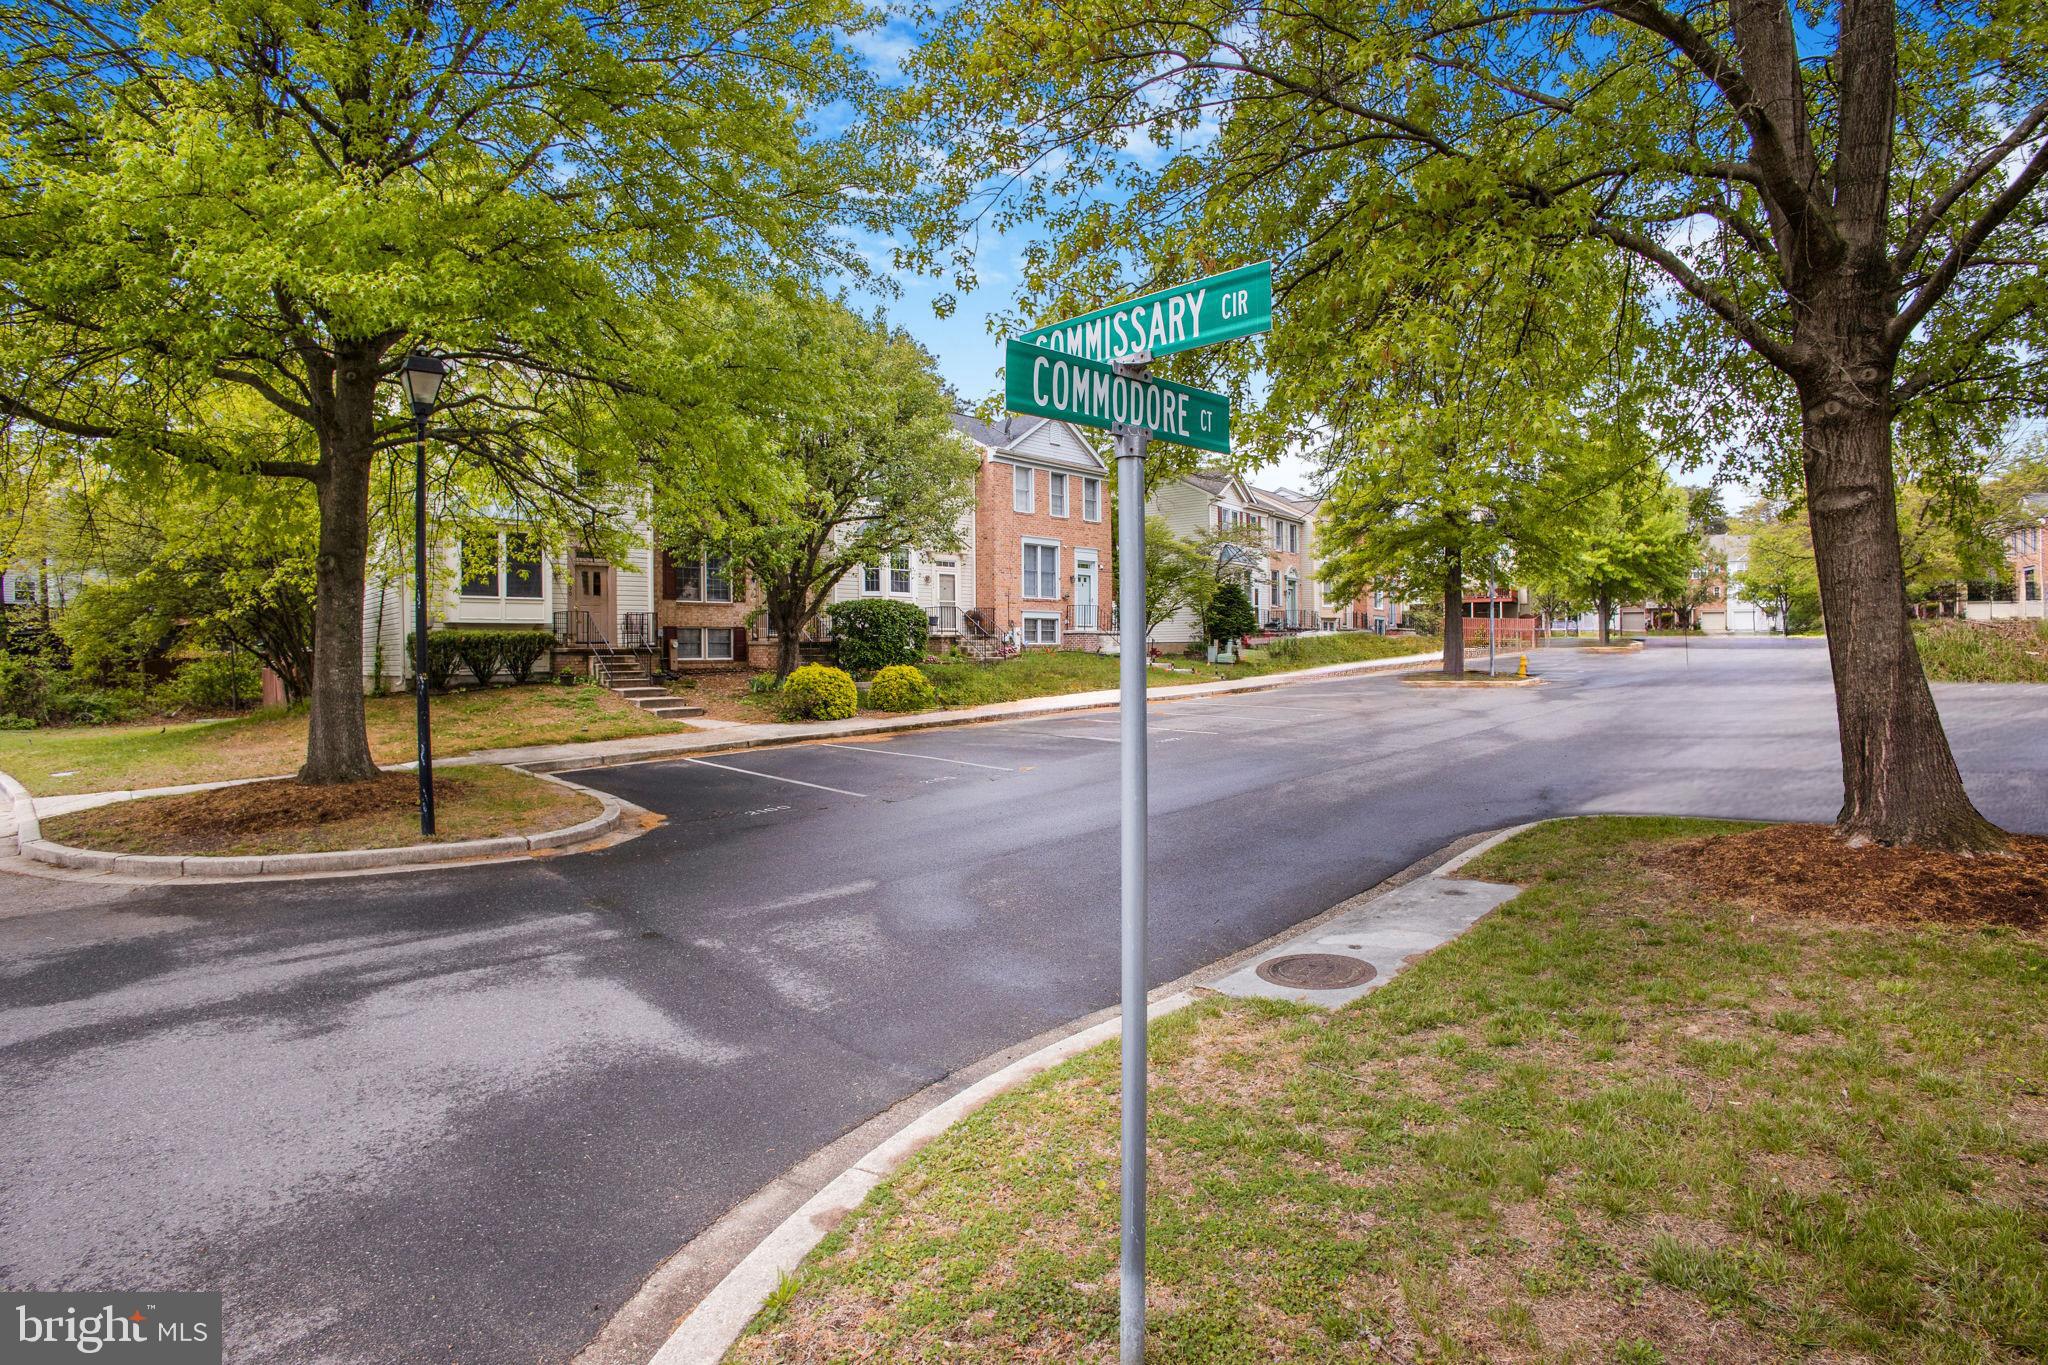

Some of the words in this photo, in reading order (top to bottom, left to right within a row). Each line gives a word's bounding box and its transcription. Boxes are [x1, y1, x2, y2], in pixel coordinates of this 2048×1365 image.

[1221, 290, 1248, 320] CIR
[1034, 356, 1190, 437] COMMODORE
[1200, 410, 1213, 432] CT
